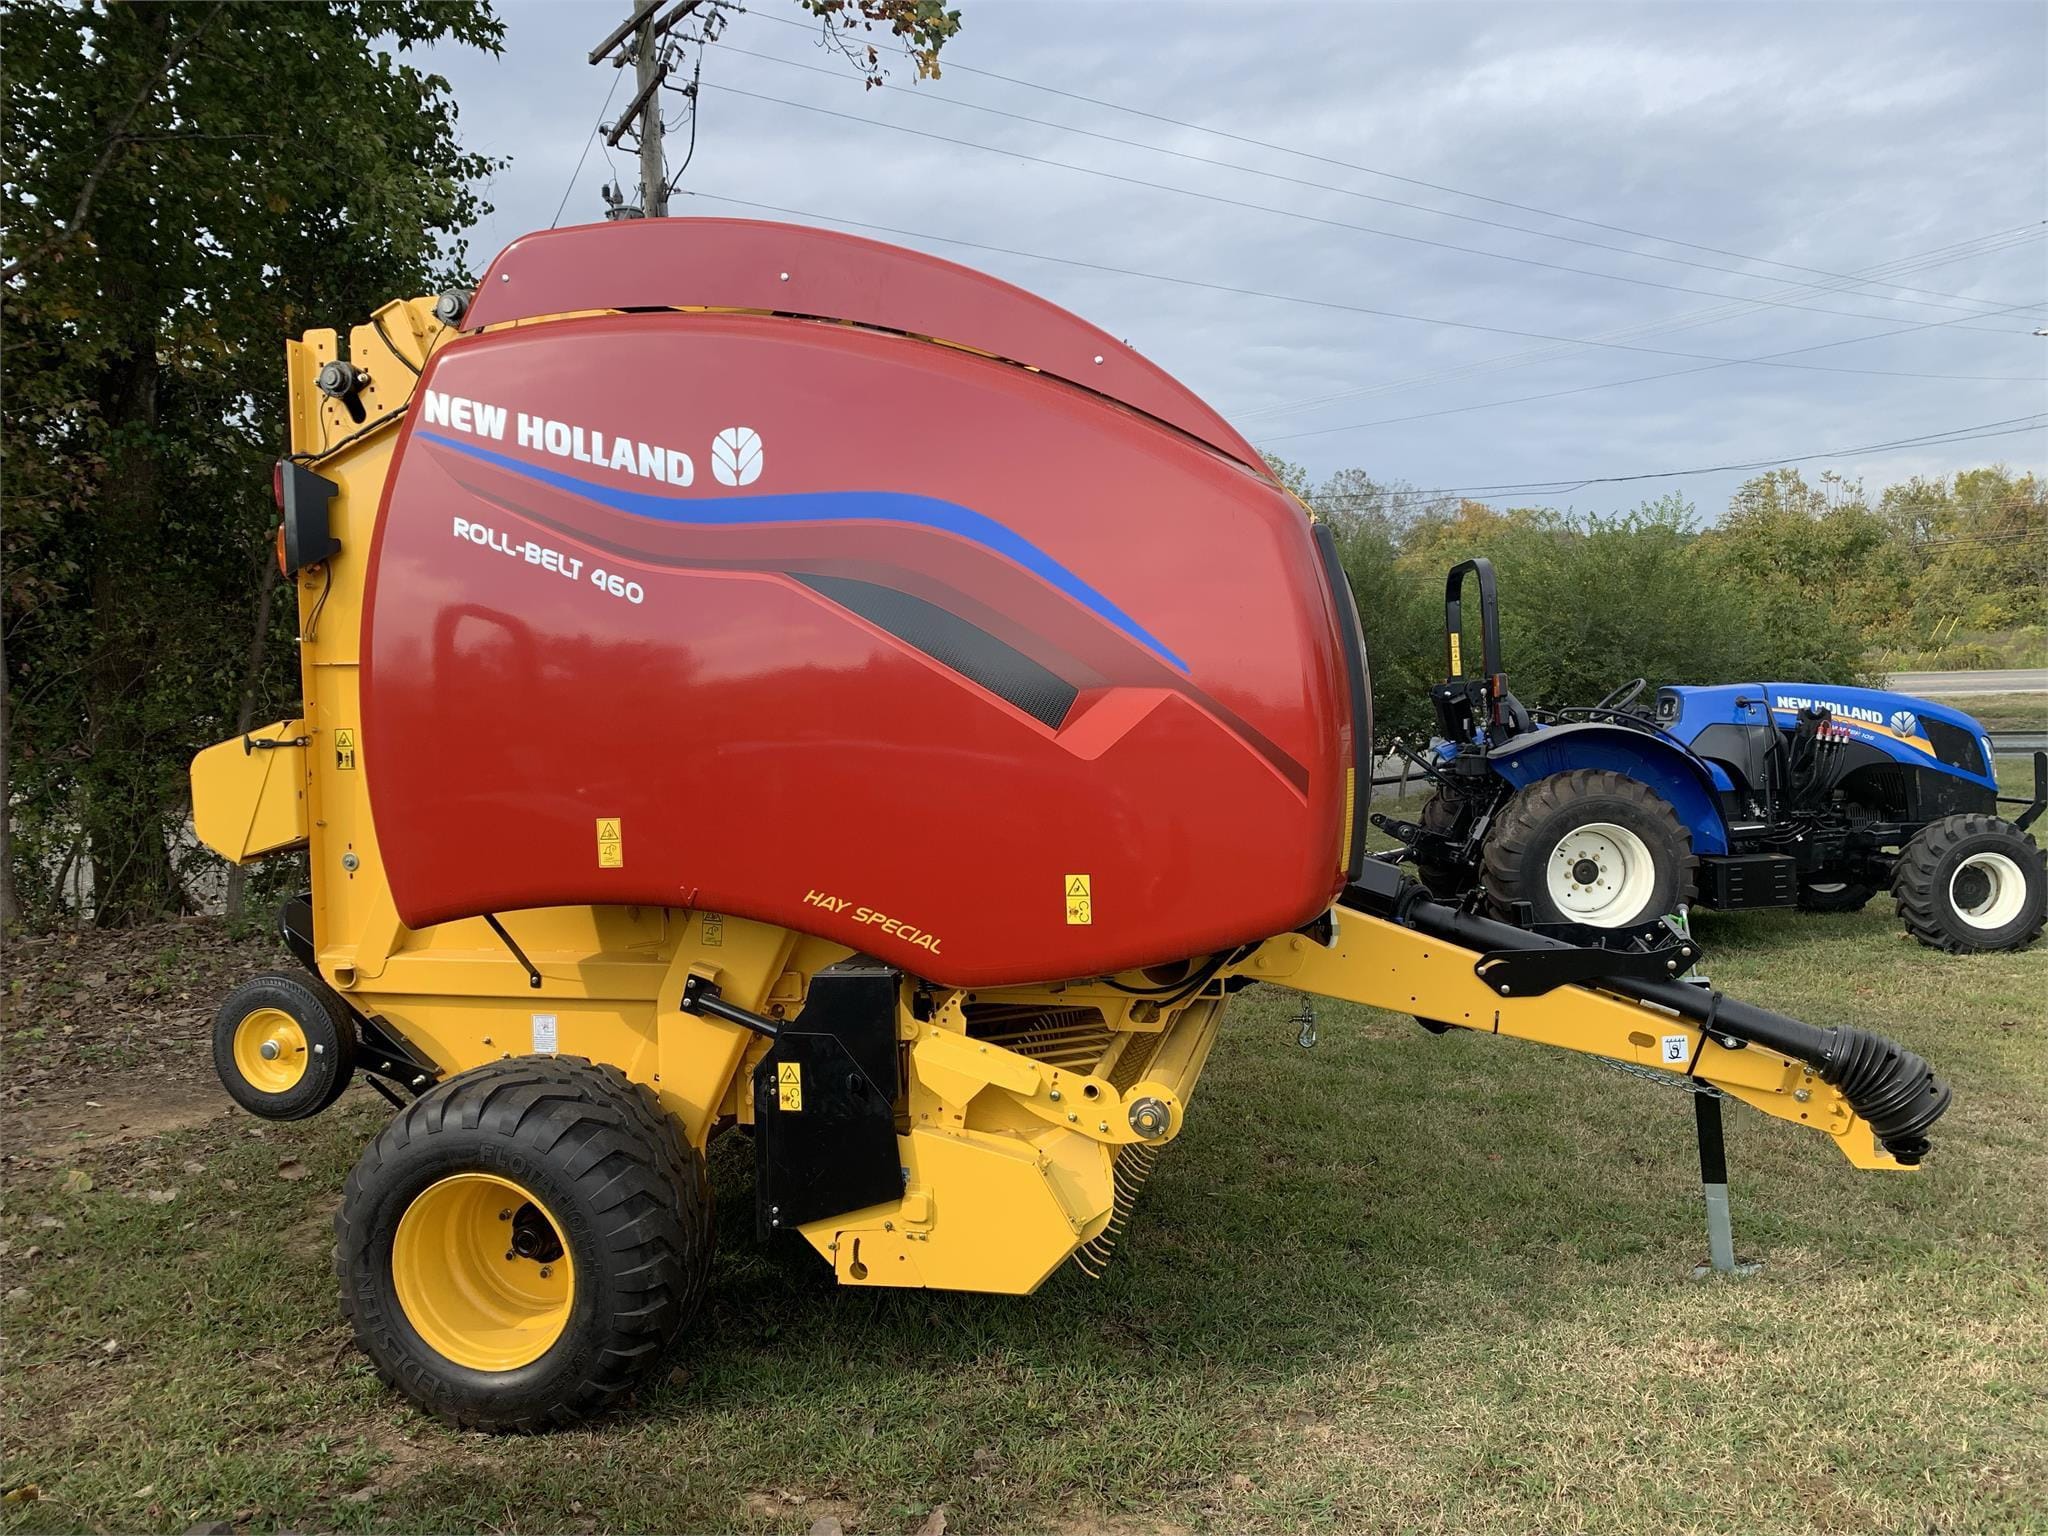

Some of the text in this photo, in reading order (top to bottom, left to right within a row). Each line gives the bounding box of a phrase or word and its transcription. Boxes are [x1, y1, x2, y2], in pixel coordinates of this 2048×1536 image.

[424, 390, 695, 487] NEW HOLLAND
[453, 516, 645, 604] ROLL-BELT 460
[1776, 696, 1883, 724] NEW HOLLAND
[803, 889, 942, 955] HAY SPECIAL
